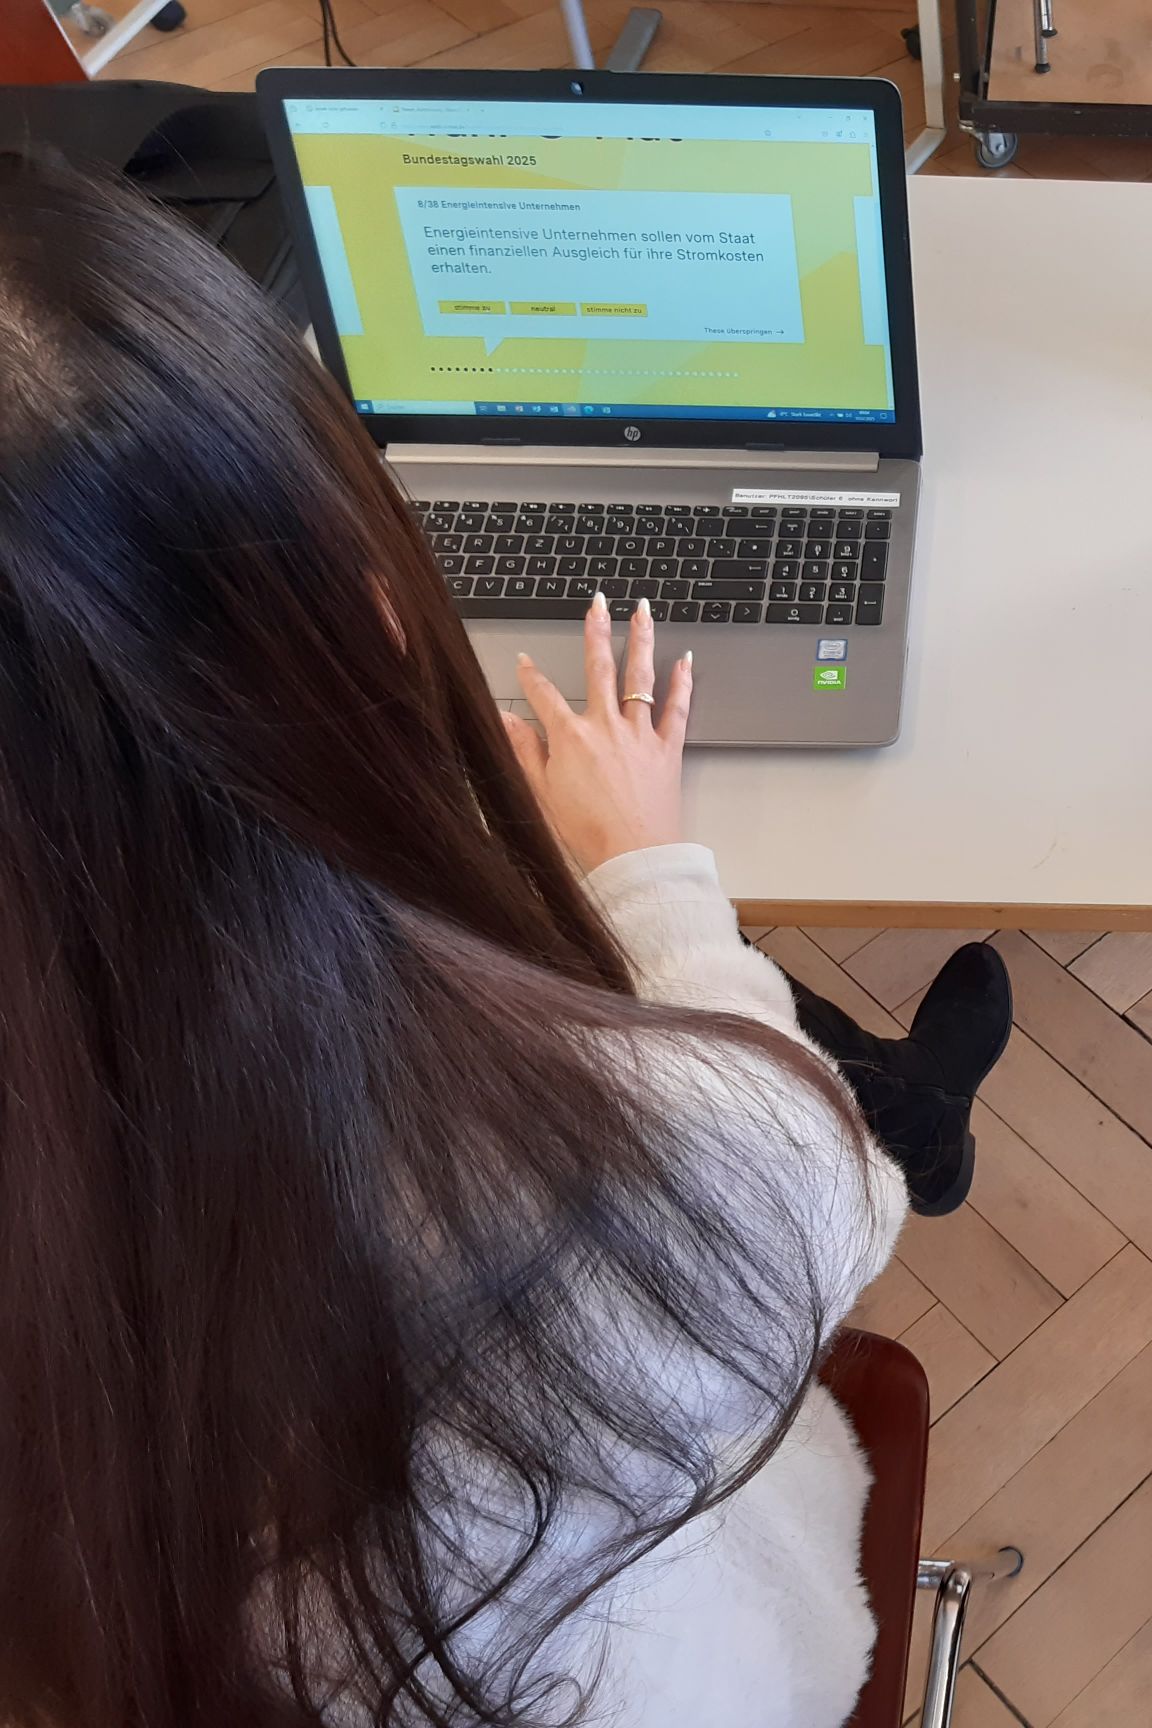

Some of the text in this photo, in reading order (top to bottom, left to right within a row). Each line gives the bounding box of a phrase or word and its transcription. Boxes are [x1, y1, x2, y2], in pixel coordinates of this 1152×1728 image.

[403, 154, 536, 167] Bundestagswahl 2025
[417, 200, 581, 211] 8/38 Energieintensive Unternehmen
[424, 226, 756, 244] Energieintensive Unternehmen sollen vom Staat
[428, 244, 764, 262] einen finanziellen Ausgleich für ihre Stromkosten
[431, 262, 492, 274] erhalten.
[726, 328, 772, 336] überspringen
[625, 426, 640, 441] hp
[444, 538, 452, 546] E
[535, 539, 544, 547] Z
[565, 540, 575, 548] U
[444, 559, 454, 567] D
[506, 560, 515, 568] G
[569, 561, 576, 569] J
[453, 580, 462, 589] C
[485, 581, 494, 589] V
[515, 581, 524, 590] B
[546, 582, 556, 590] N
[577, 582, 588, 590] M
